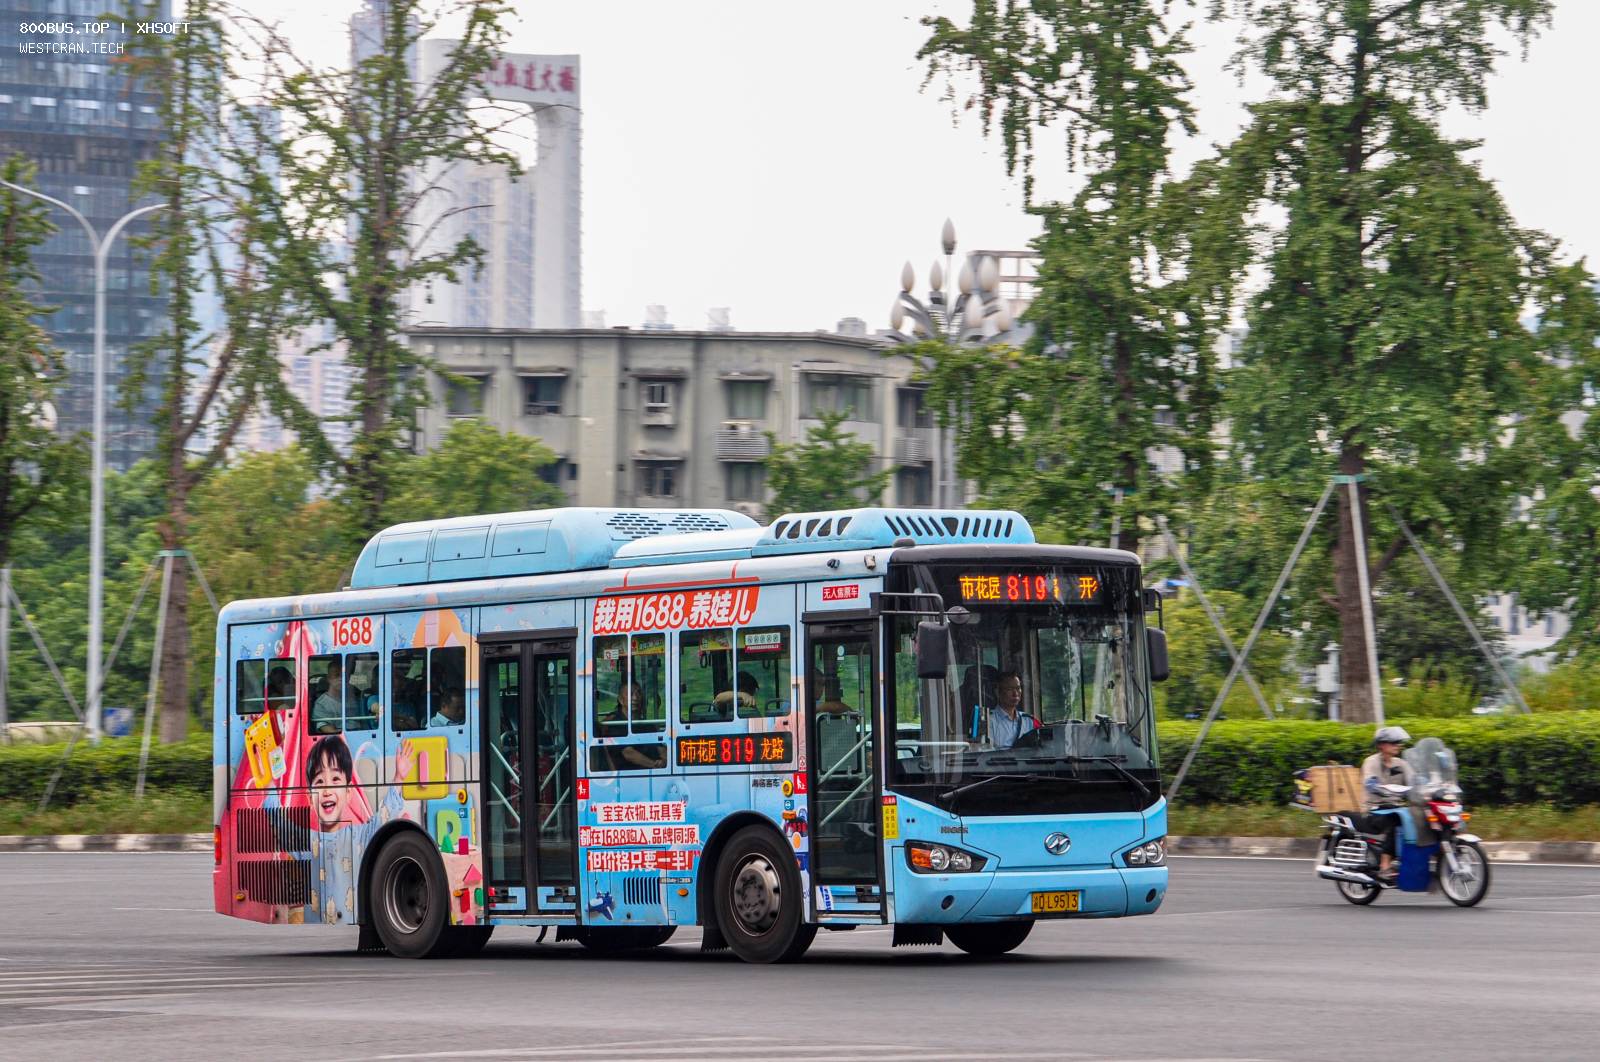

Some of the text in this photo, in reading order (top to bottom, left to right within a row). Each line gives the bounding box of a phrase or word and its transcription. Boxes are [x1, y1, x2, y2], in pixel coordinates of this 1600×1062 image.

[823, 585, 859, 600] 无人售票车
[1007, 575, 1047, 600] 819
[332, 616, 373, 647] 1688
[721, 737, 754, 763] 819
